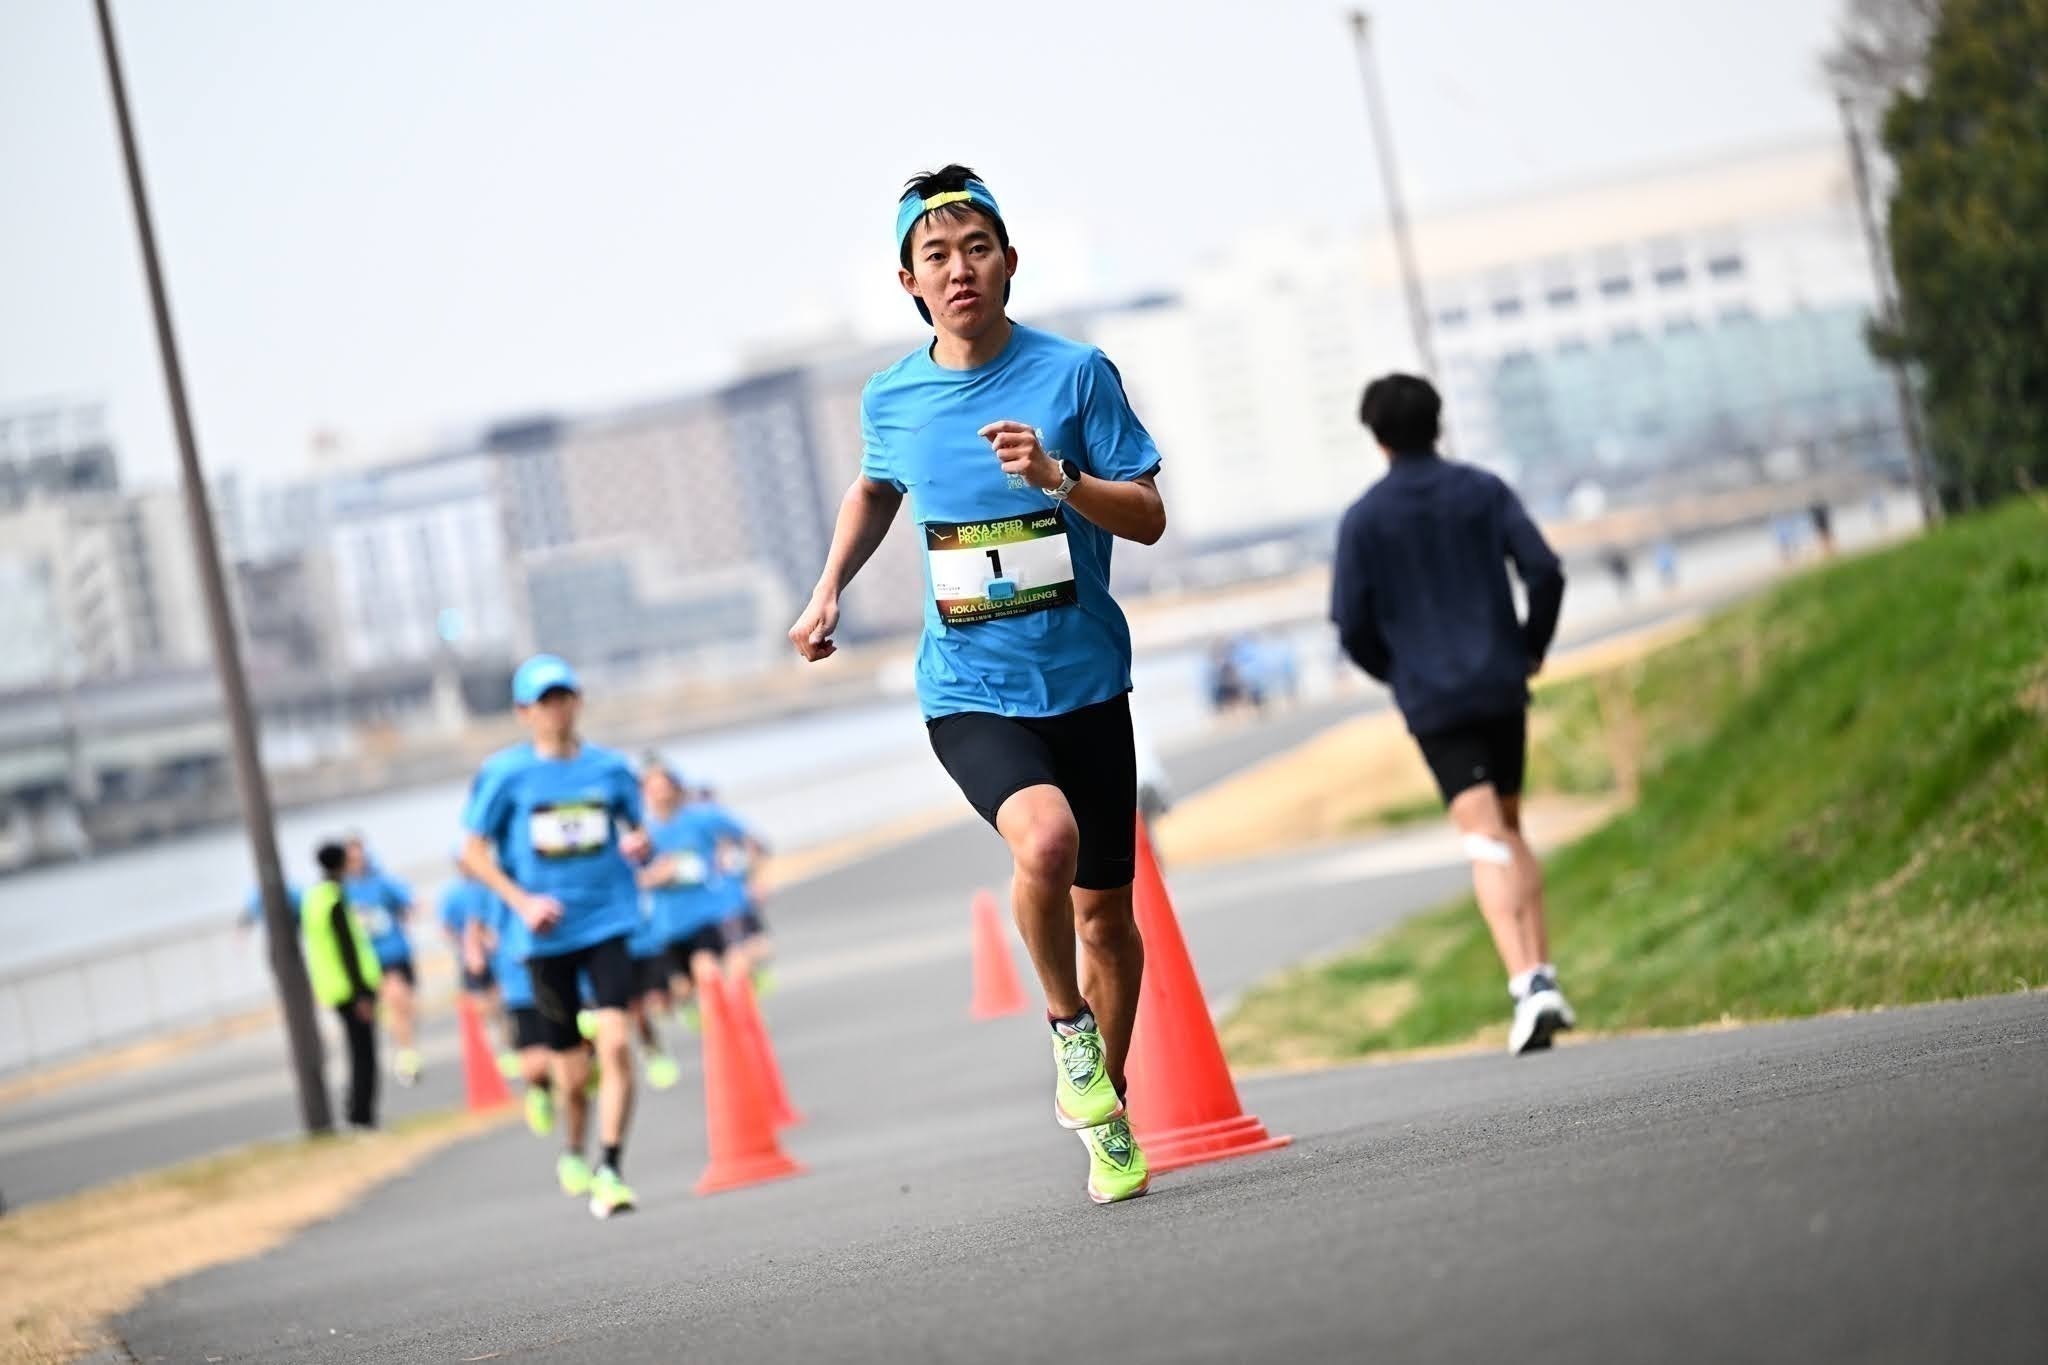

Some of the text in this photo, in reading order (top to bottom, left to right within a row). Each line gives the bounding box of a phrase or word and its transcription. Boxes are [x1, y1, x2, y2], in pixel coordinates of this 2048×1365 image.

[957, 519, 1023, 536] HOKA SPEED
[1031, 517, 1057, 529] HOKA
[958, 530, 1002, 544] PROJECT
[986, 549, 1004, 578] 1
[949, 603, 977, 615] HOKA
[977, 600, 1003, 611] CIELO
[1004, 589, 1058, 607] CHALLENGE
